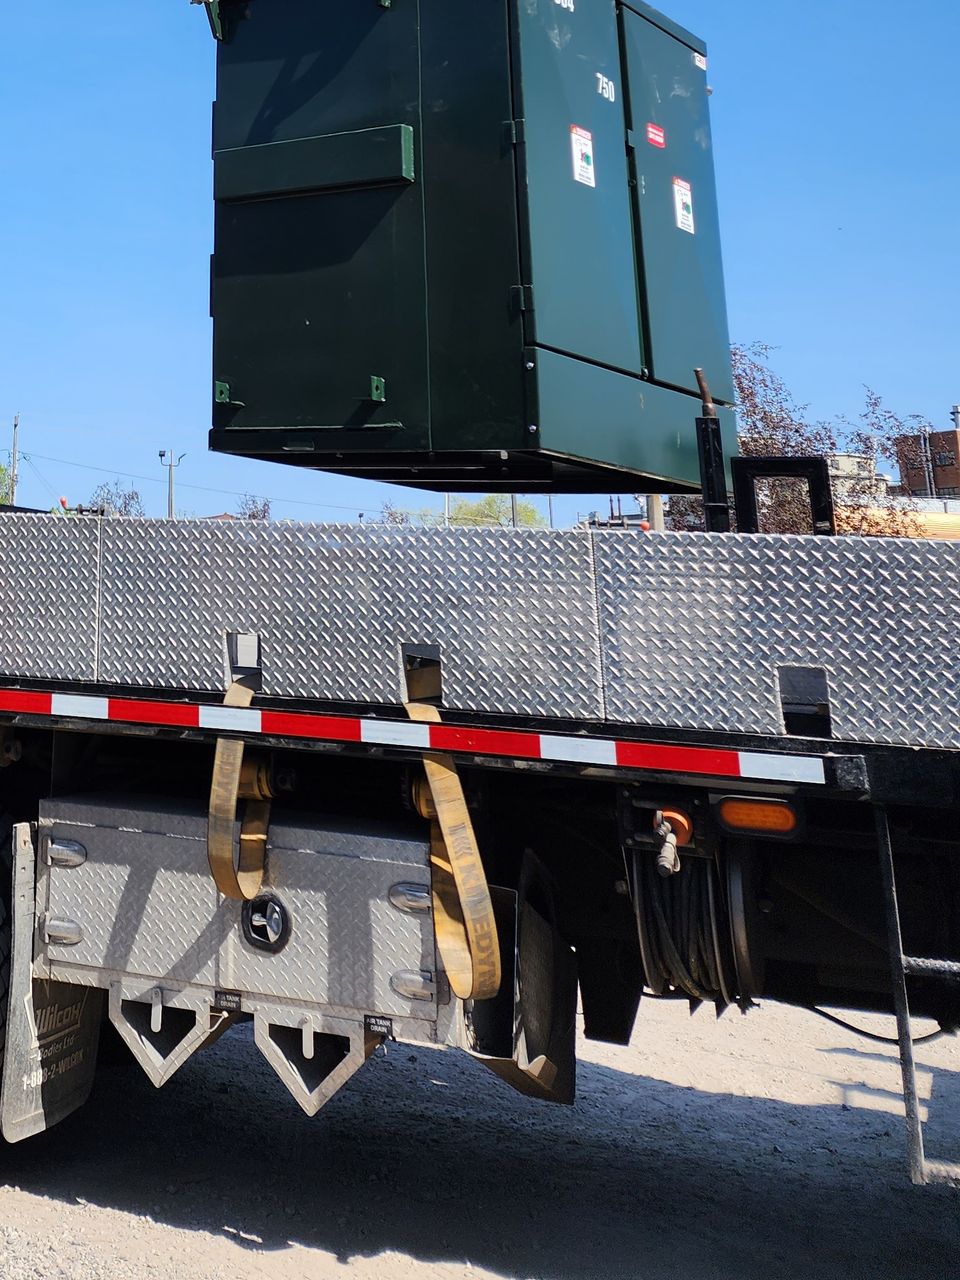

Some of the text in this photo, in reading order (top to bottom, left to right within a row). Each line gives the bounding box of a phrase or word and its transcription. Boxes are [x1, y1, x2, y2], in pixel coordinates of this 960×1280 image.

[595, 72, 615, 102] 750
[376, 1018, 390, 1026] TANK
[371, 1025, 387, 1033] DRAIN
